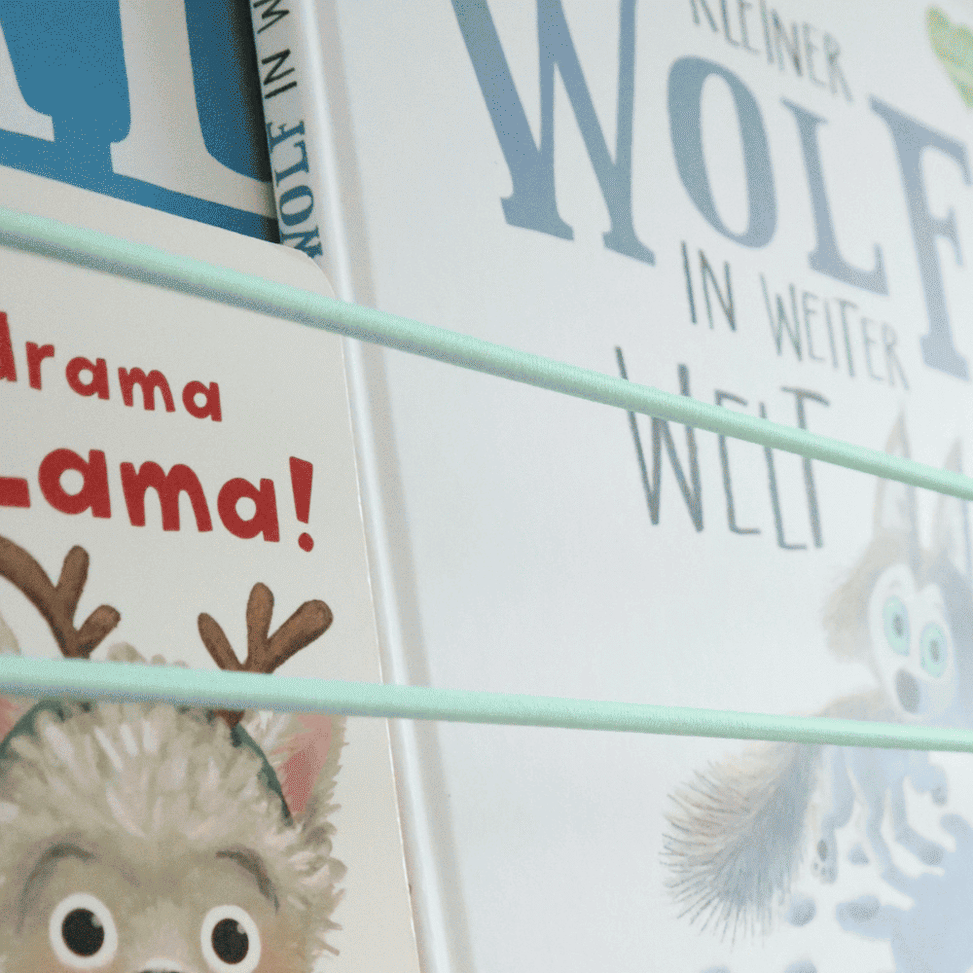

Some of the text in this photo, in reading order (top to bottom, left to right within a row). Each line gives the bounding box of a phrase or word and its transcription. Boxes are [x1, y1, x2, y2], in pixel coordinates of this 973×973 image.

[261, 49, 299, 100] IN
[679, 239, 910, 391] IN WEITER
[614, 345, 831, 551] WELT
